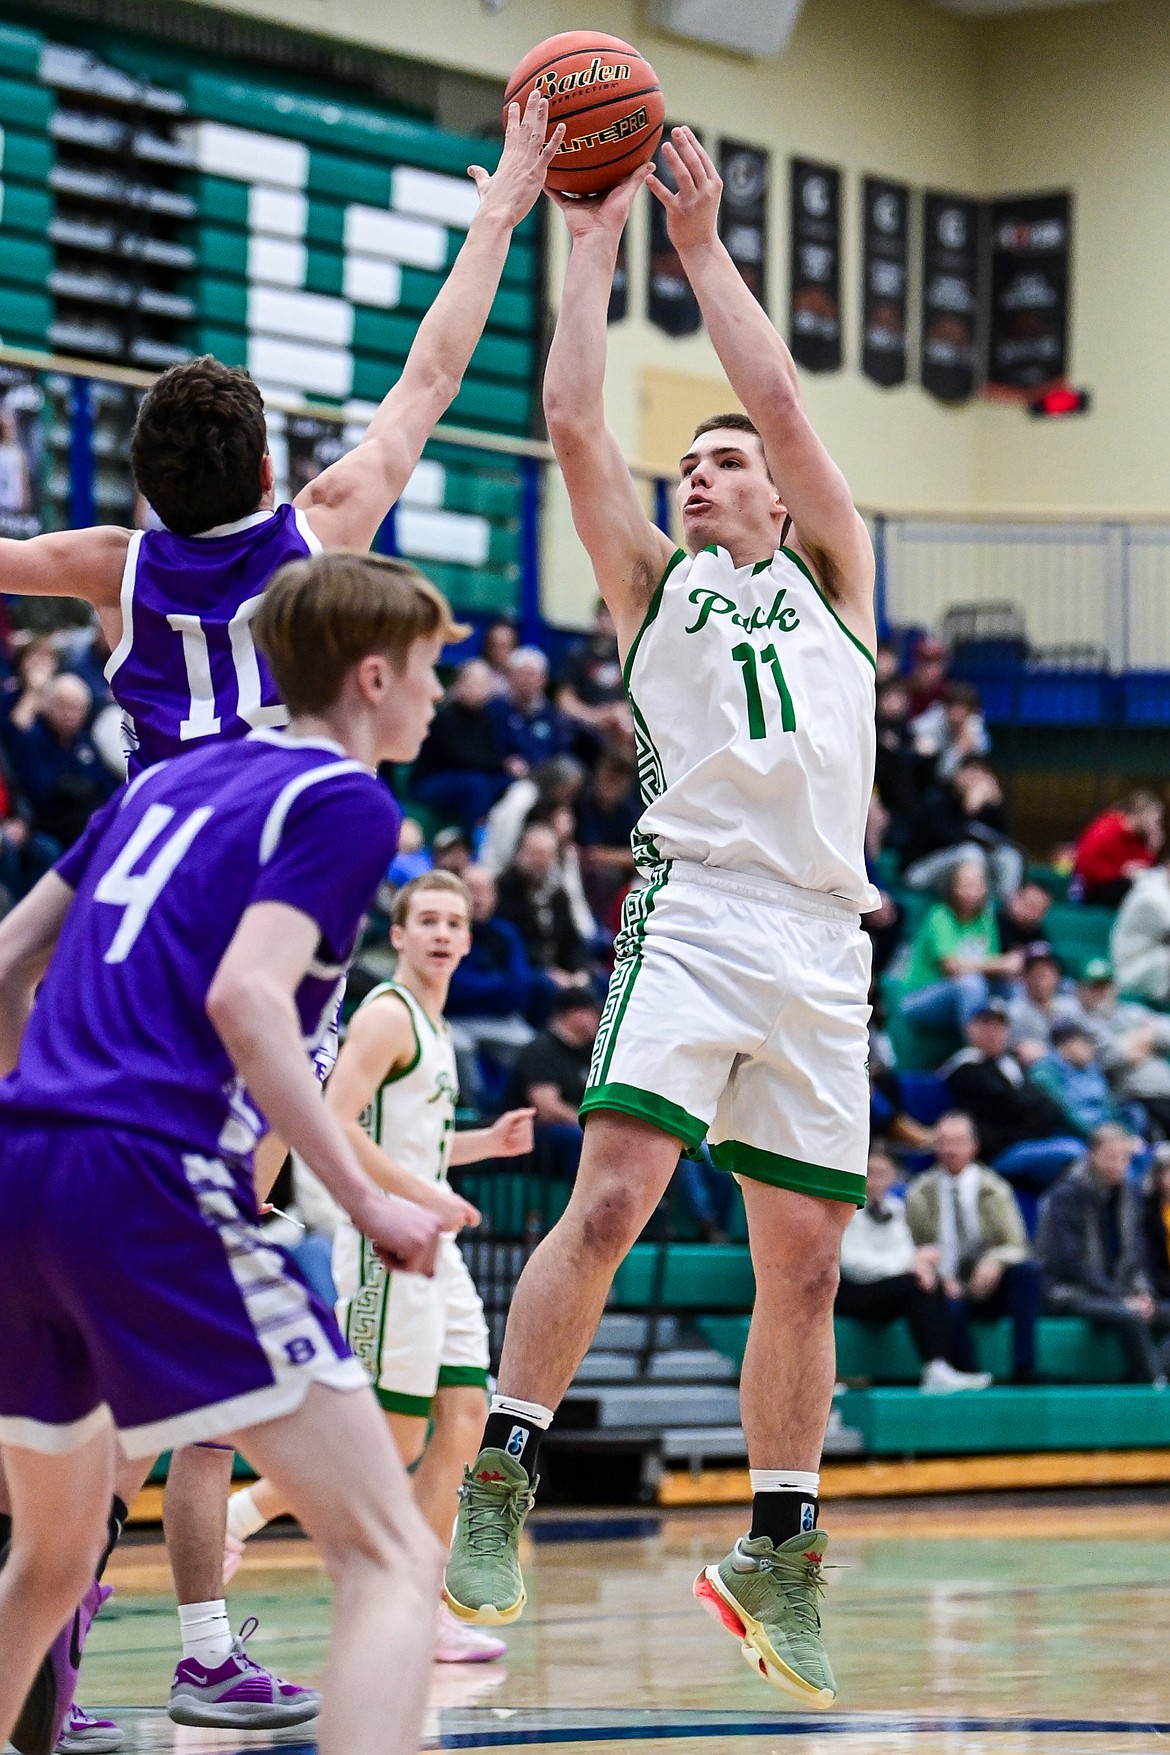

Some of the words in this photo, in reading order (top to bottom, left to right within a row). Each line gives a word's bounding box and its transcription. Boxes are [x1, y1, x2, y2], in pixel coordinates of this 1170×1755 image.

[535, 57, 631, 100] Baden
[619, 111, 647, 137] PRO
[685, 588, 800, 634] Pack
[731, 642, 796, 740] 11
[94, 802, 215, 964] 4
[284, 1337, 316, 1366] B
